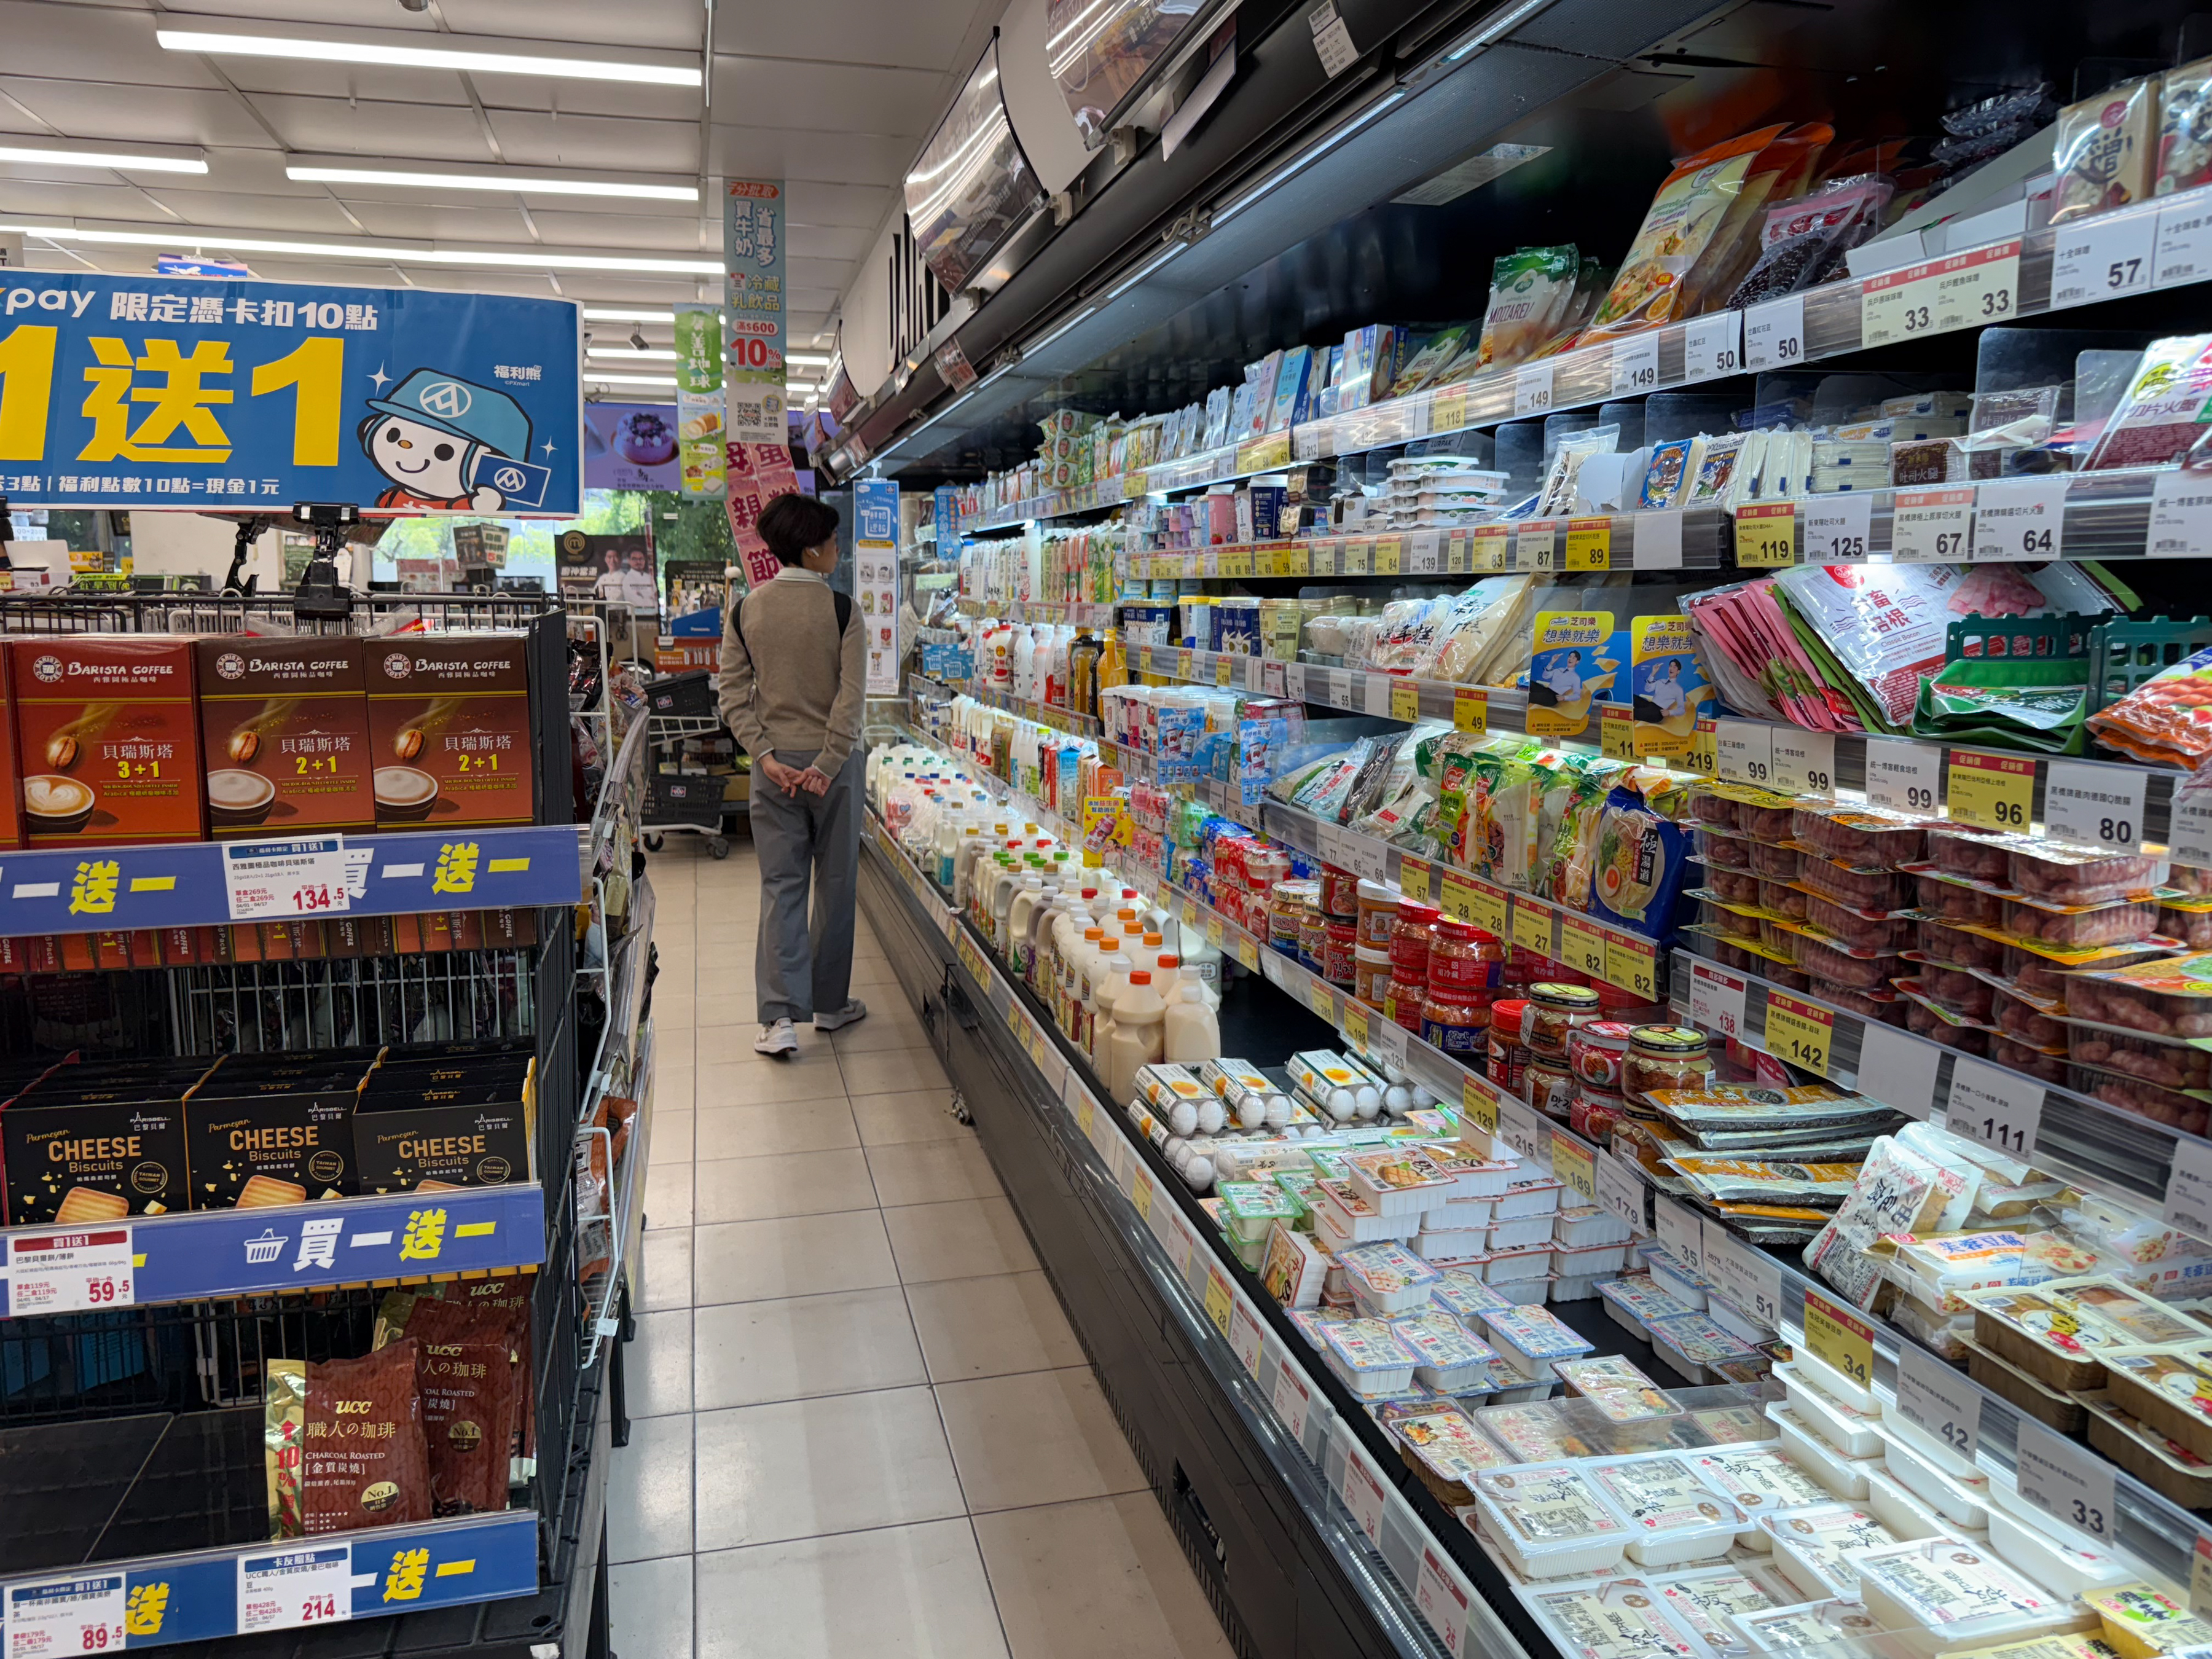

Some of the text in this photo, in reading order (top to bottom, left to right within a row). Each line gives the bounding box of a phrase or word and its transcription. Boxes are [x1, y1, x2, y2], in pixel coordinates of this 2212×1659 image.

[735, 184, 775, 198] 分批取
[735, 200, 754, 257] 買牛奶
[1945, 257, 1967, 269] 促銷價
[1907, 266, 1928, 279] 促銷價
[2108, 258, 2143, 288] 57
[748, 274, 781, 292] 冷藏
[1870, 276, 1891, 289] 促銷價
[0, 287, 96, 318] pay
[110, 291, 378, 331] 限定憑卡扣10點
[731, 292, 780, 312] 乳飲品
[1982, 289, 2010, 316] 33
[737, 321, 775, 334] 滿$600
[1905, 307, 1929, 331] 33
[1778, 336, 1798, 358] 50
[1716, 350, 1735, 369] 50
[494, 365, 541, 381] 福利熊
[1631, 367, 1655, 386] 149
[1529, 390, 1549, 407] 149
[1445, 410, 1461, 425] 118
[1306, 444, 1317, 457] 212
[0, 475, 41, 492] 3點
[1899, 468, 1939, 483] 吐司火腿
[59, 476, 280, 496] 福利點數10點=現金1元
[1808, 517, 1846, 527] 新東陽吐司火腿
[1760, 539, 1789, 560] 119
[1830, 537, 1863, 556] 125
[1936, 533, 1962, 554] 67
[2023, 530, 2052, 552] 64
[1357, 559, 1366, 571] 75
[1388, 558, 1397, 570] 84
[1421, 556, 1436, 570] 139
[1451, 556, 1462, 565] 120
[1491, 554, 1503, 568] 83
[1537, 551, 1550, 566] 87
[1589, 548, 1604, 565] 89
[1325, 561, 1333, 573] 75
[1571, 616, 1596, 626] 芝司樂
[1542, 629, 1601, 645] 想樂就樂
[1880, 630, 1921, 647] Classic Bacon
[132, 664, 173, 675] COFFEE
[310, 660, 349, 670] COFFEE
[473, 660, 511, 670] COFFEE
[1341, 695, 1349, 707] 55
[1406, 706, 1417, 720] 72
[1472, 715, 1483, 729] 49
[102, 743, 174, 760] 貝瑞斯塔
[280, 736, 351, 755] 貝瑞斯塔
[444, 735, 512, 753] 貝瑞斯塔
[1686, 751, 1713, 771] 219
[1747, 761, 1767, 780] 99
[1808, 771, 1829, 791] 99
[1907, 786, 1932, 809] 99
[1994, 801, 2023, 825] 96
[2098, 818, 2132, 844] 80
[1329, 849, 1338, 861] 77
[1639, 831, 1658, 882] 極湯道
[232, 858, 315, 871] 西雅圖極品咖啡貝瑞斯塔
[1375, 868, 1384, 881] 69
[0, 859, 177, 917] 一送一
[1416, 885, 1427, 900] 57
[1457, 903, 1469, 918] 28
[1490, 915, 1502, 931] 28
[1535, 933, 1548, 950] 27
[1585, 954, 1601, 971] 82
[1634, 973, 1650, 994] 82
[1320, 1005, 1332, 1019] 289
[1719, 1014, 1735, 1033] 138
[1354, 1029, 1367, 1044] 198
[1390, 1052, 1405, 1070] 129
[1791, 1039, 1822, 1068] 142
[1550, 1094, 1572, 1111] 맛김
[208, 1118, 252, 1133] Parmesan
[1476, 1109, 1494, 1131] 129
[26, 1128, 71, 1144] Parmesan
[229, 1126, 319, 1151] CHEESE
[377, 1129, 419, 1144] Parmesan
[1983, 1118, 2025, 1152] 111
[48, 1135, 142, 1163] CHEESE
[398, 1134, 486, 1159] CHEESE
[1515, 1134, 1534, 1156] 215
[248, 1148, 302, 1162] Biscuits
[417, 1155, 469, 1169] Biscuits
[68, 1159, 124, 1173] Biscuits
[1570, 1171, 1591, 1195] 189
[1615, 1196, 1638, 1225] 179
[53, 1234, 90, 1249] 買1送1
[292, 1207, 497, 1273] 買一送一
[1936, 1234, 2026, 1253] 芙蓉豆腐
[1681, 1244, 1698, 1267] 35
[1755, 1294, 1774, 1320] 51
[1217, 1308, 1227, 1330] 28
[422, 1359, 487, 1380] 人の珈琲
[1843, 1354, 1866, 1382] 34
[442, 1388, 475, 1398] ROASTED
[306, 1421, 396, 1440] 職人の珈琲
[1292, 1416, 1300, 1435] 15
[1940, 1421, 1969, 1452] 42
[305, 1451, 385, 1460] CHARCOAL ROASTED
[2071, 1499, 2104, 1534] 33
[1365, 1517, 1375, 1539] 34
[302, 1599, 335, 1621] 214
[1445, 1626, 1456, 1650] 25
